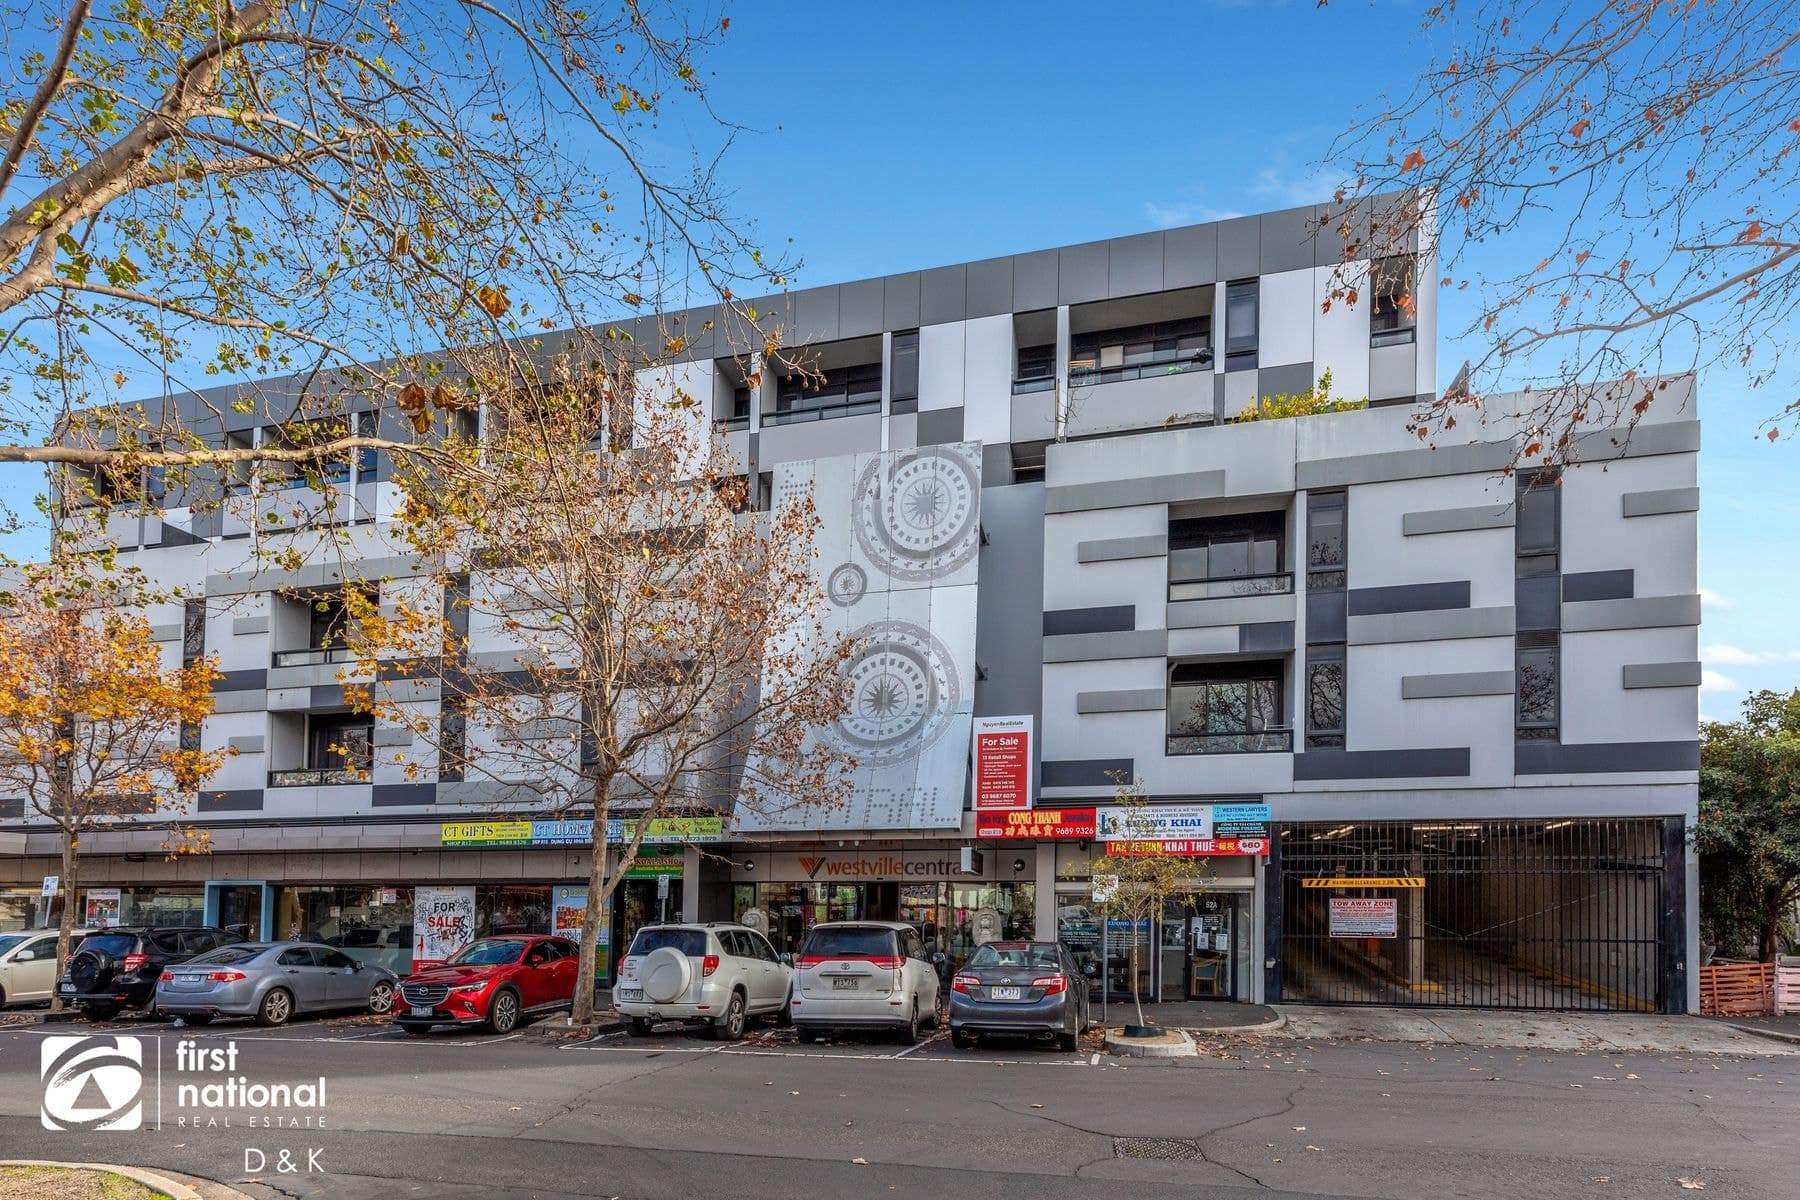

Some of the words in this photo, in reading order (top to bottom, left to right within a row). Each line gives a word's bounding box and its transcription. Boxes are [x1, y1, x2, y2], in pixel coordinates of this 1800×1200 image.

[982, 738, 998, 746] For
[1000, 736, 1019, 746] Sale
[1008, 812, 1032, 824] CONG
[1032, 811, 1062, 824] THANH
[1171, 819, 1202, 827] KHAI
[444, 826, 458, 838] CT
[462, 826, 494, 837] GIFTS
[533, 824, 548, 836] CT
[1165, 842, 1187, 852] KHAI
[826, 856, 967, 876] westvillecentra
[434, 902, 456, 913] FOR
[428, 916, 460, 927] SALE
